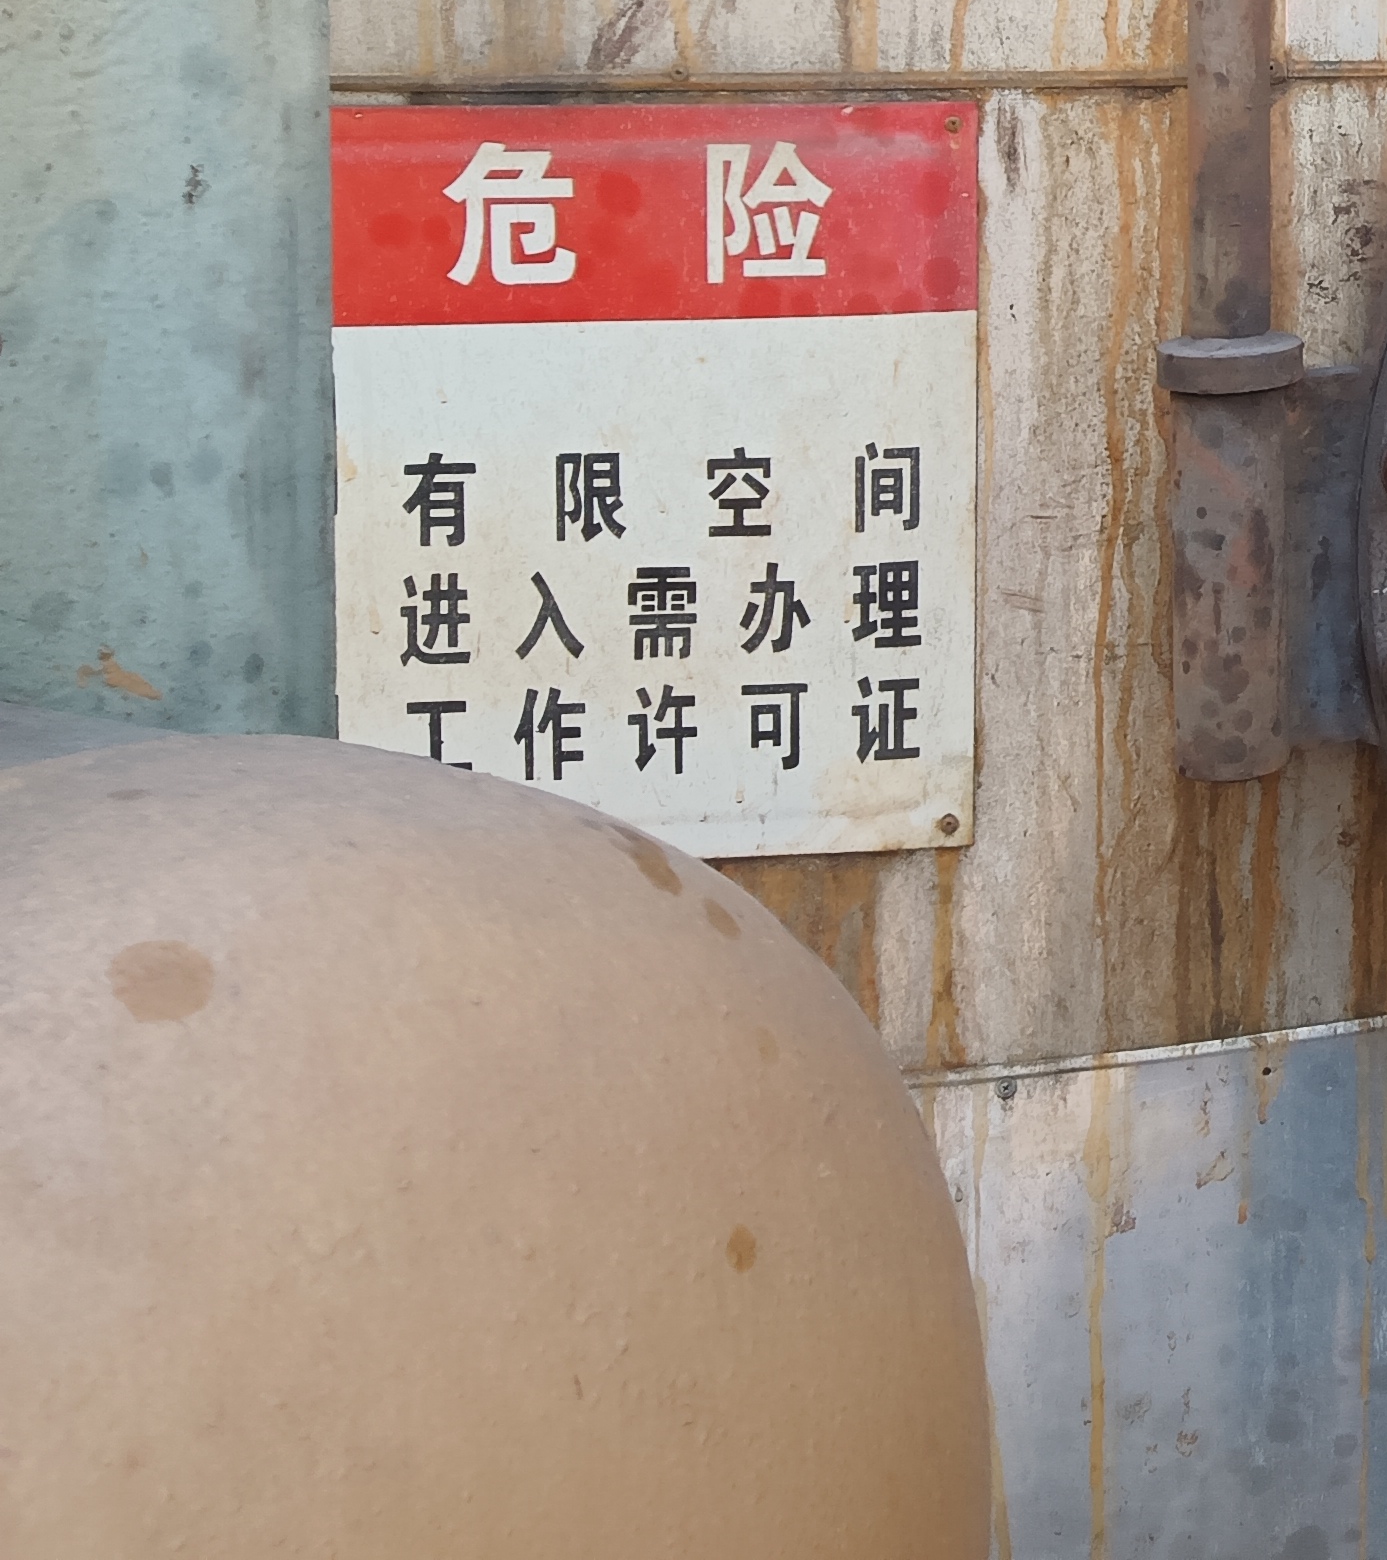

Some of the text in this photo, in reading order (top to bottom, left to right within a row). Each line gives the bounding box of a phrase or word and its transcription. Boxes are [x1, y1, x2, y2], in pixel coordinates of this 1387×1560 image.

[443, 141, 834, 287] 危险
[402, 442, 922, 547] 有限空间
[400, 560, 922, 667] 进入需办理
[406, 676, 921, 781] 工作许可证
